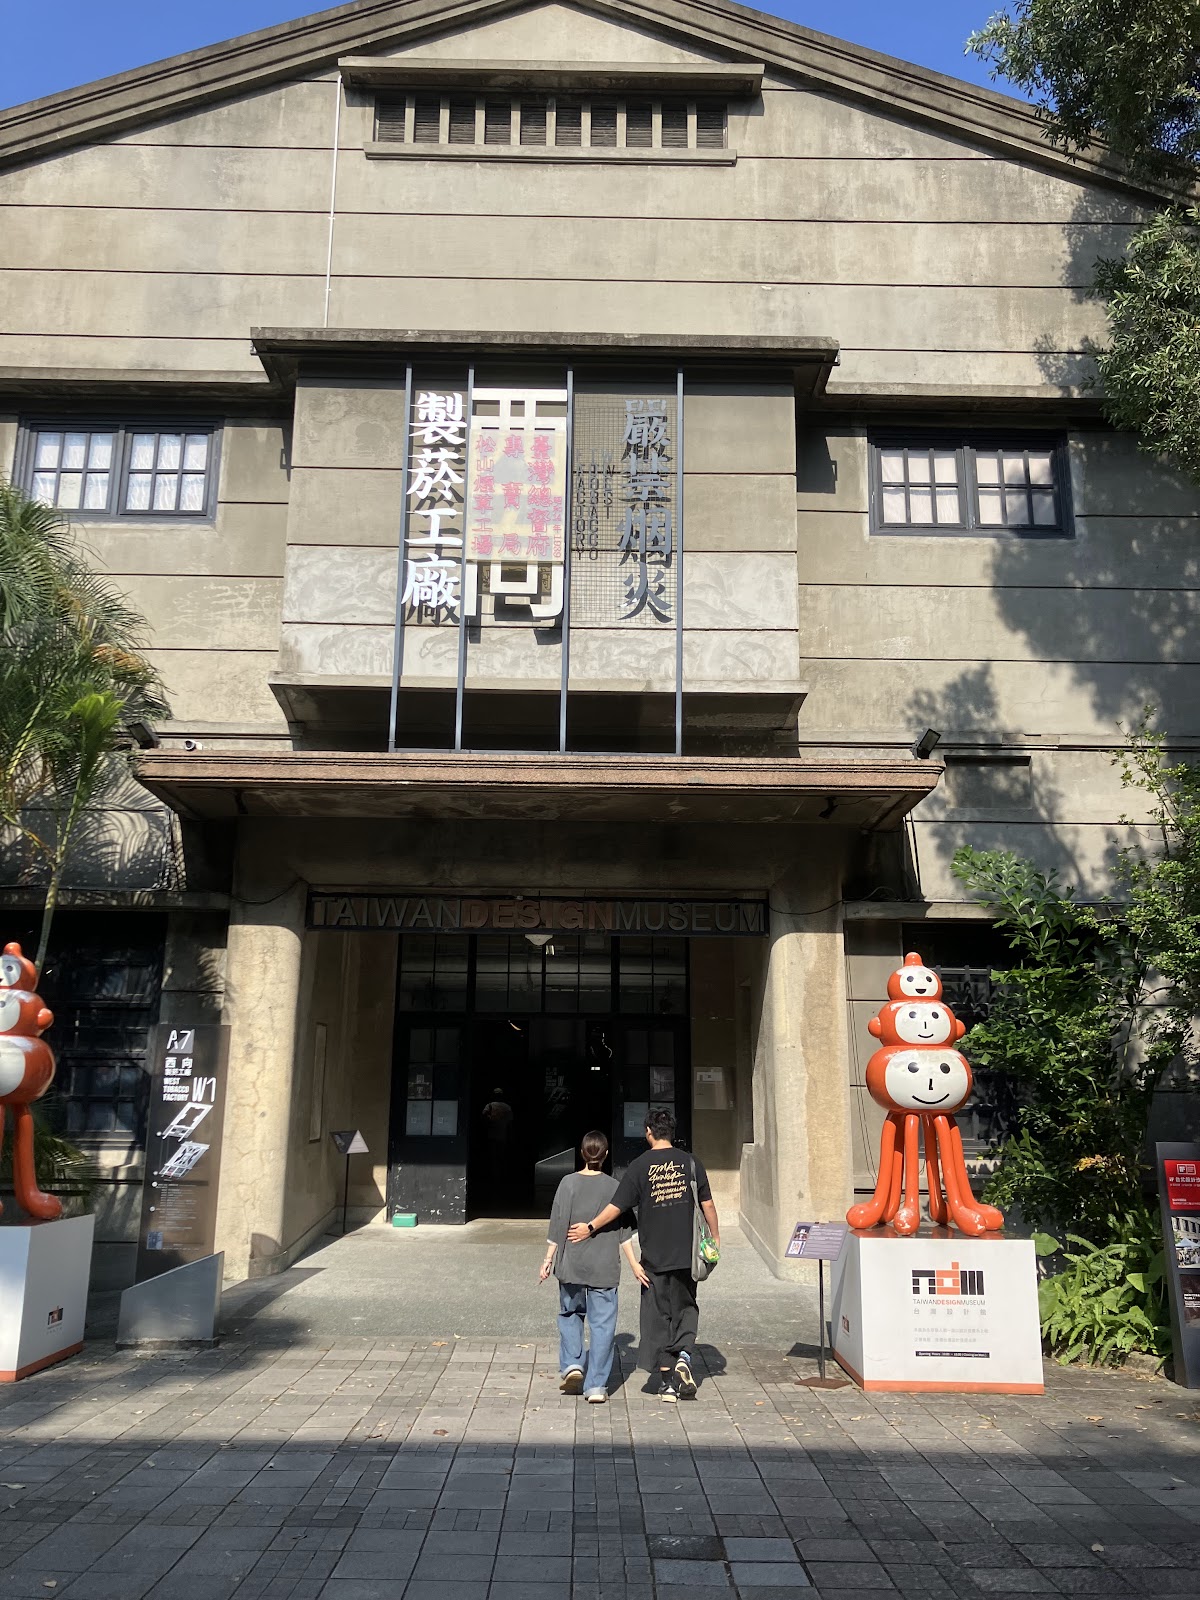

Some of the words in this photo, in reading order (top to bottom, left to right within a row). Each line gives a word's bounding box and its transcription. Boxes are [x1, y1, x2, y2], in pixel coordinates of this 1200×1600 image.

[401, 392, 467, 608] 製菸工廠
[498, 435, 525, 556] 專賣局
[526, 434, 555, 556] 臺灣總督府
[166, 1029, 192, 1050] A7
[162, 1094, 189, 1102] FACTORY
[192, 1077, 217, 1102] W1
